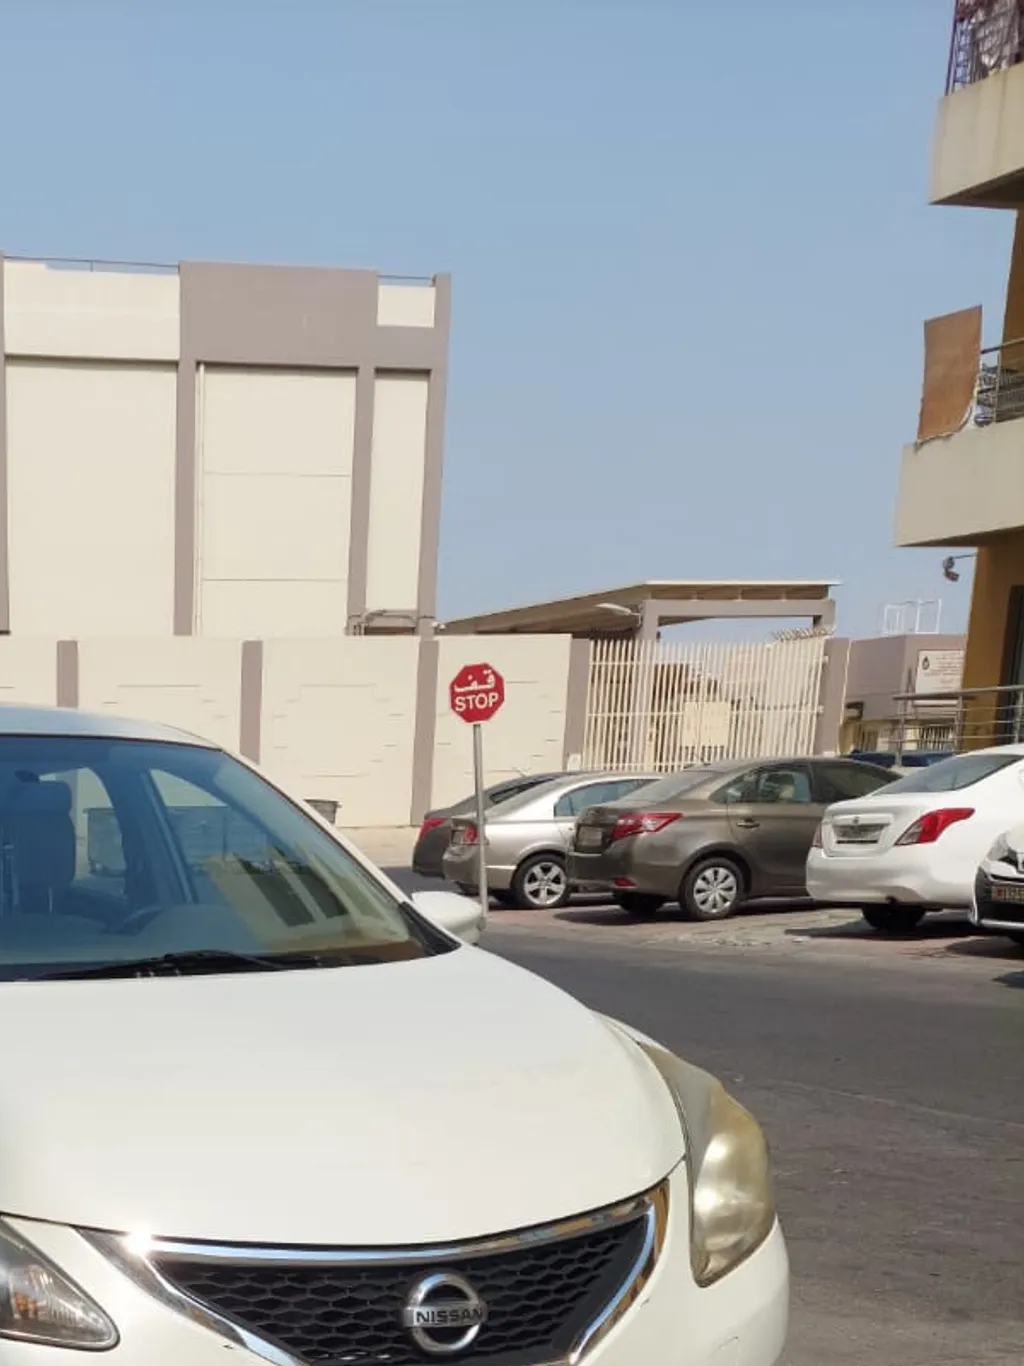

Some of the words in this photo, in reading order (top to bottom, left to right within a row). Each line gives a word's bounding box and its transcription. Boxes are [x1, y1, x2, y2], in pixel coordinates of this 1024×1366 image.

[454, 669, 495, 692] قف
[455, 692, 499, 711] STOP
[416, 1307, 483, 1323] NISSAN
